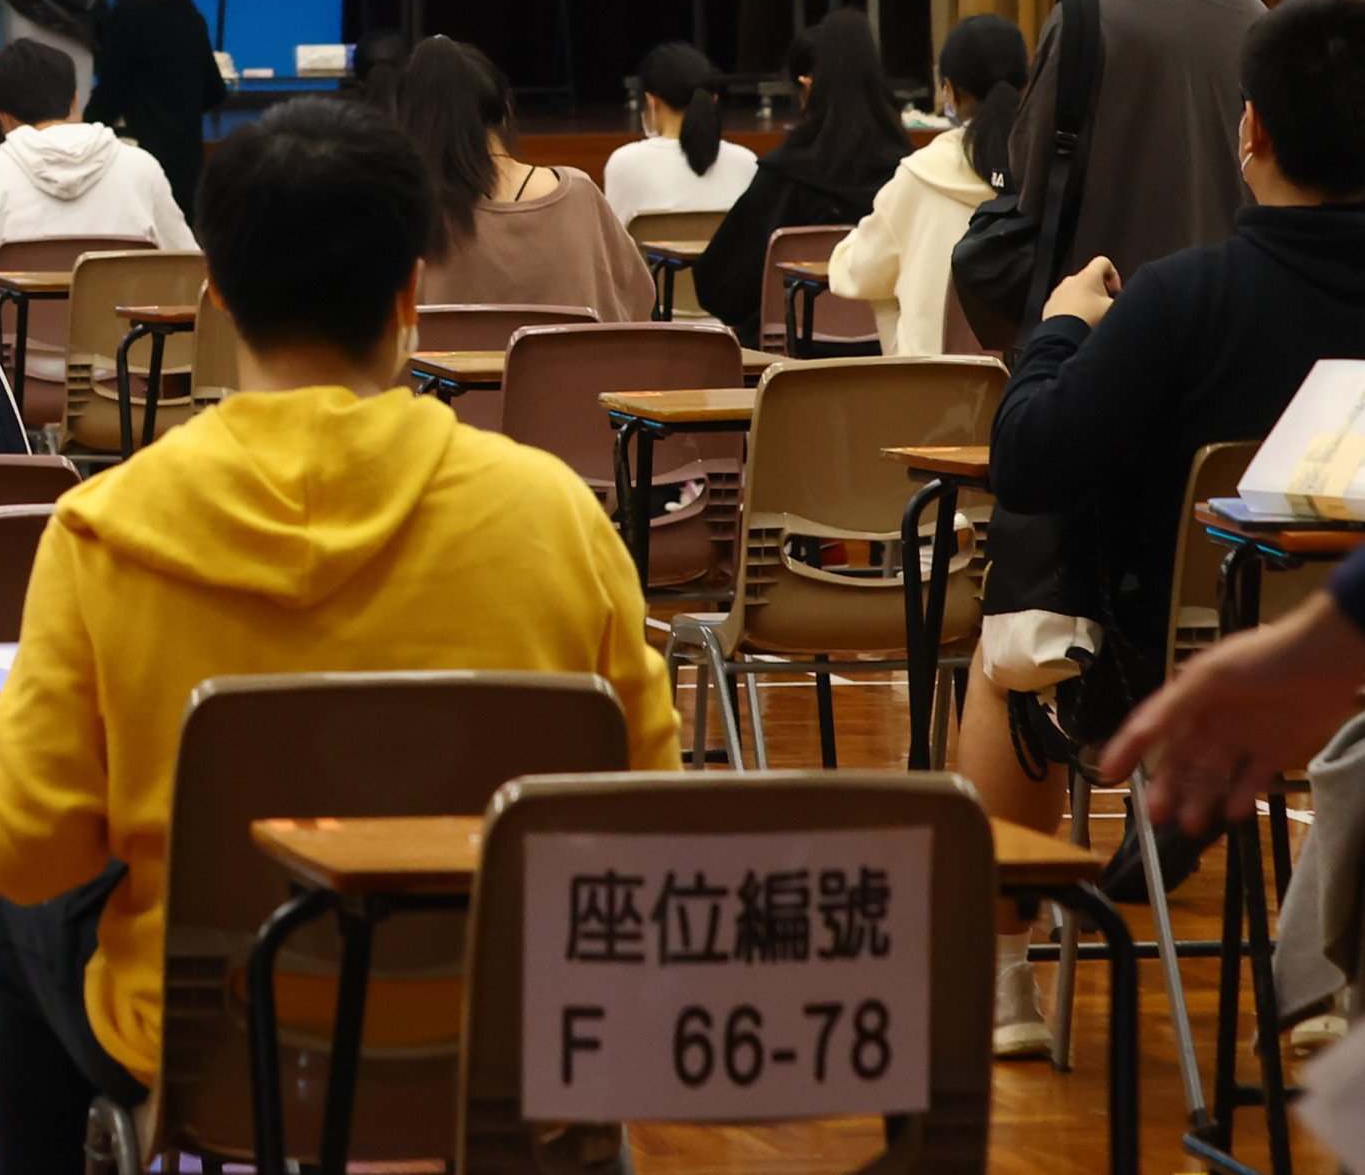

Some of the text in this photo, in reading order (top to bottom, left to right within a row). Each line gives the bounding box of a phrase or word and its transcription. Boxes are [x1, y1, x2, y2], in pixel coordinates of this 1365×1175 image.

[565, 865, 893, 966] 座位編號
[560, 998, 895, 1091] F 66-78
